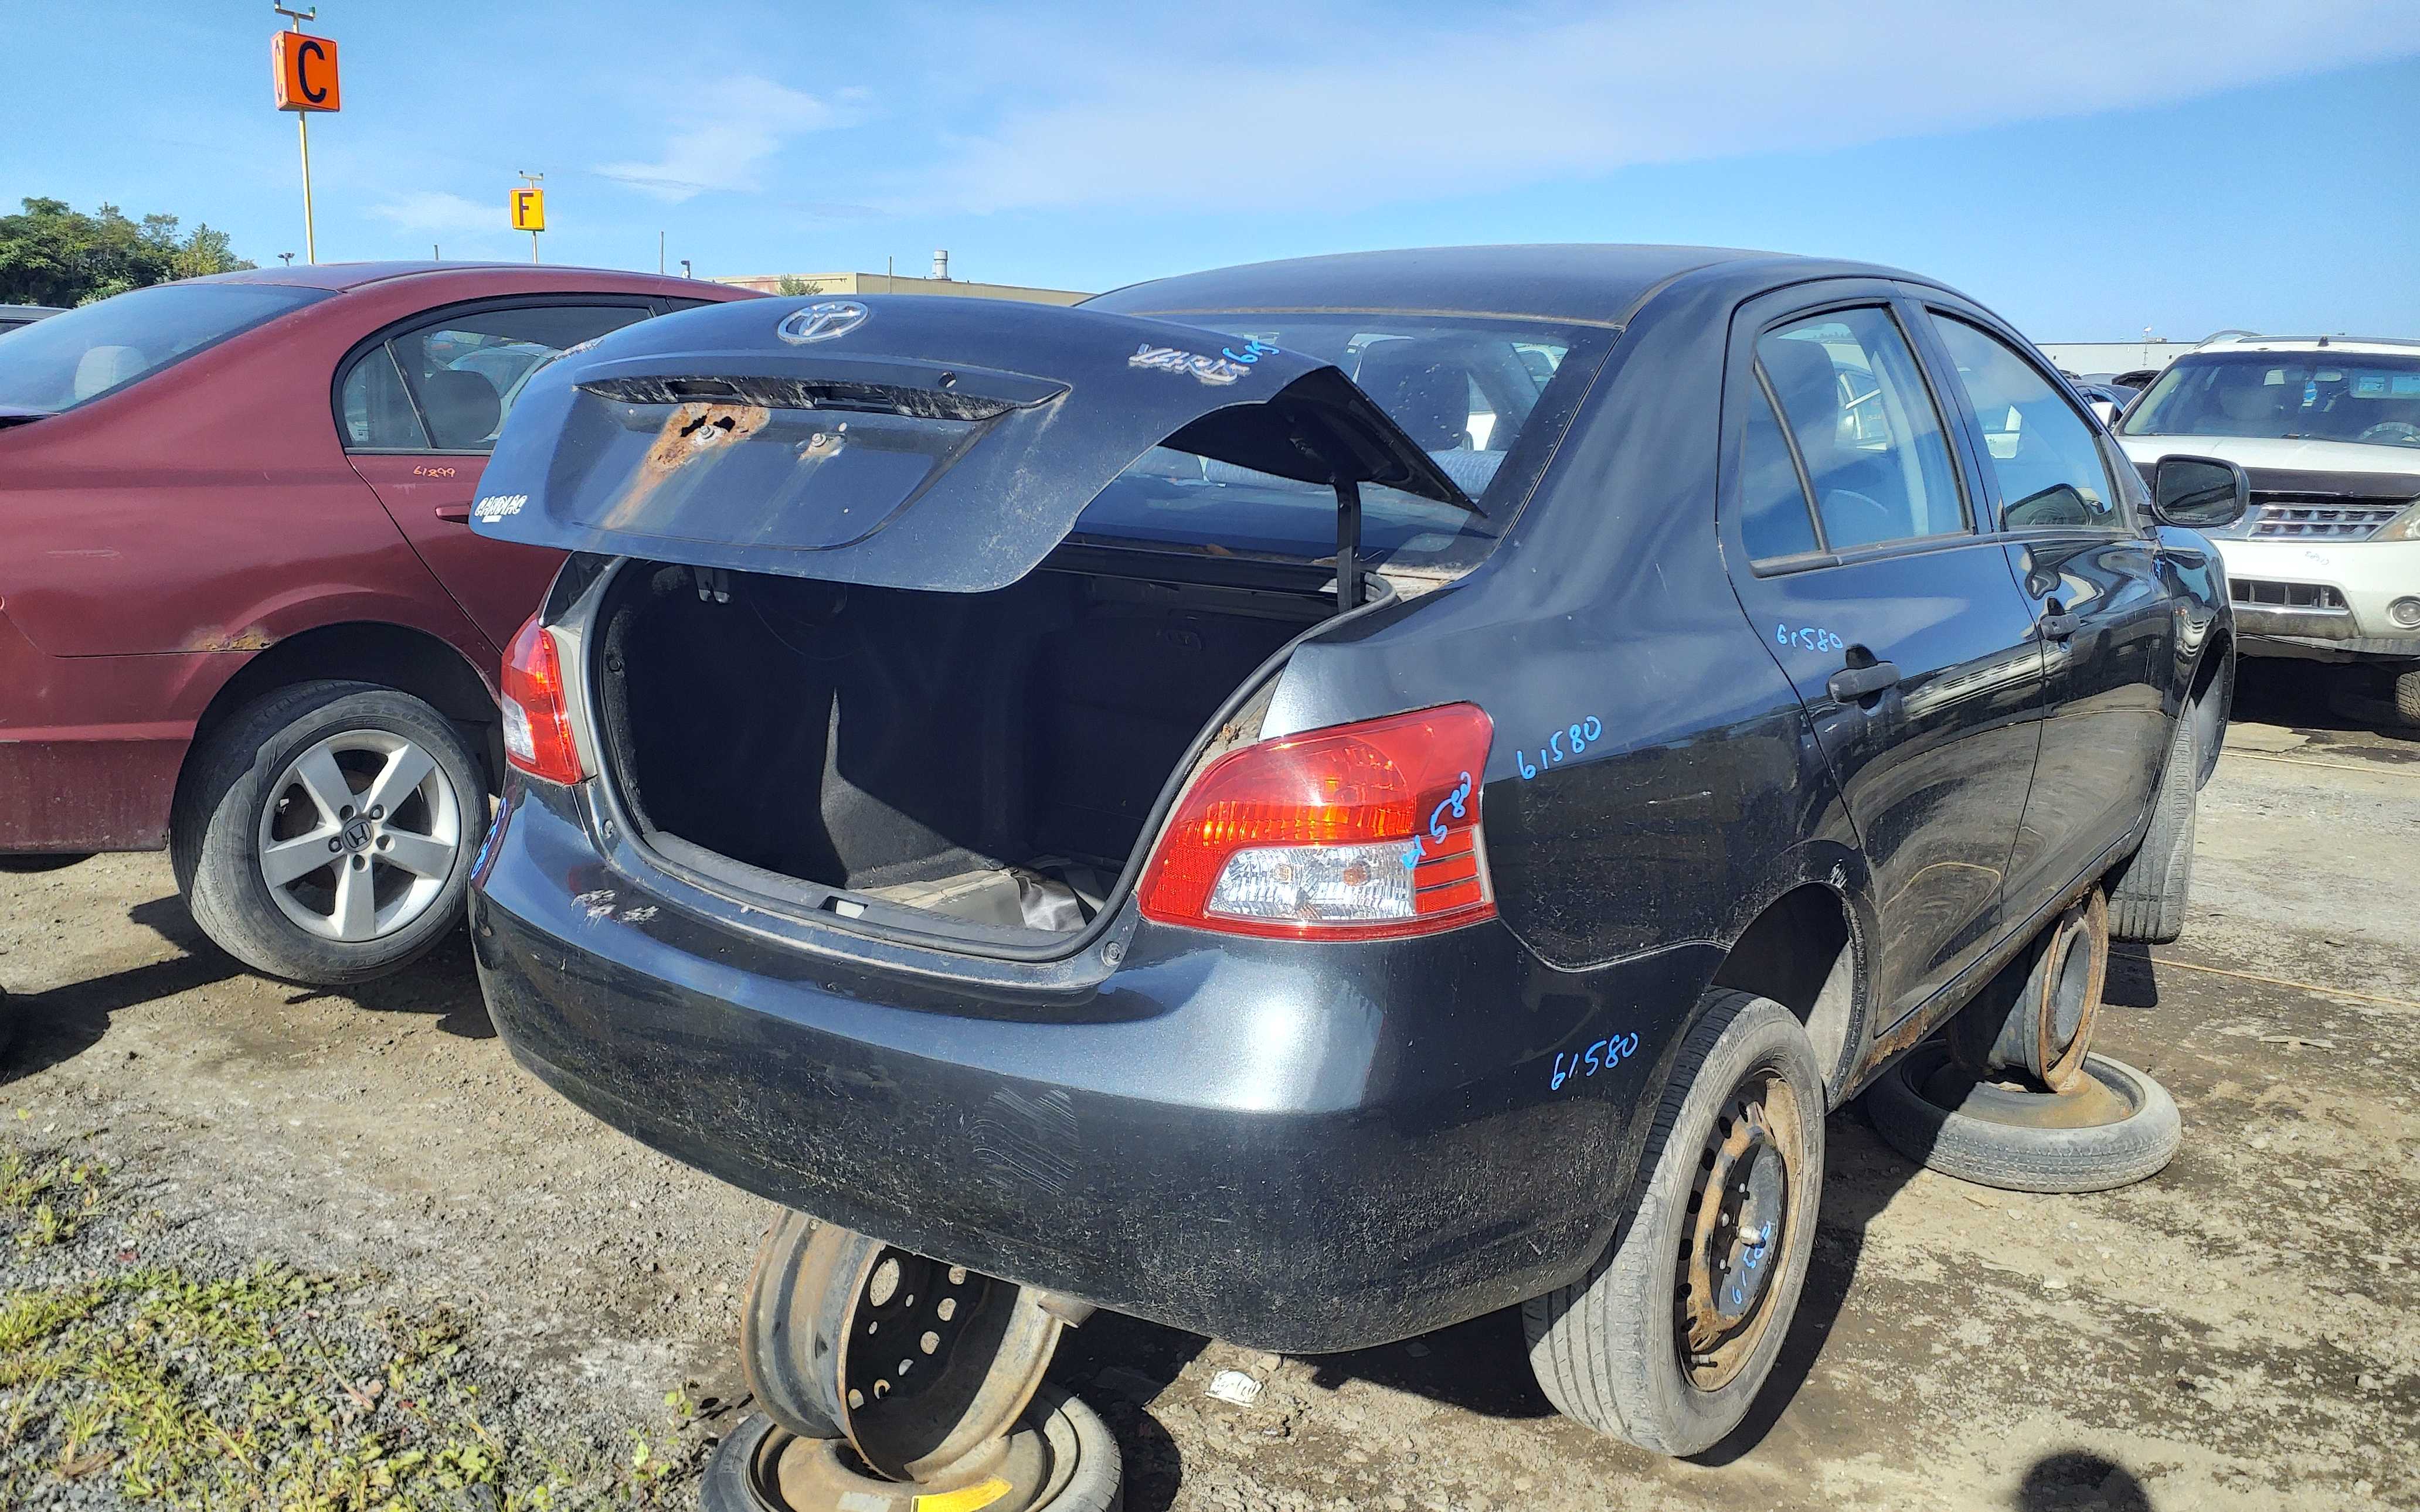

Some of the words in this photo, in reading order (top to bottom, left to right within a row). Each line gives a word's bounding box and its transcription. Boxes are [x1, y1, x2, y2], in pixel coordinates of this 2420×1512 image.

[298, 40, 327, 103] C
[518, 192, 534, 226] F
[413, 465, 455, 478] 61899
[1776, 624, 1843, 652] 61580
[1517, 715, 1602, 780] 61580
[1551, 1032, 1639, 1091] 61580
